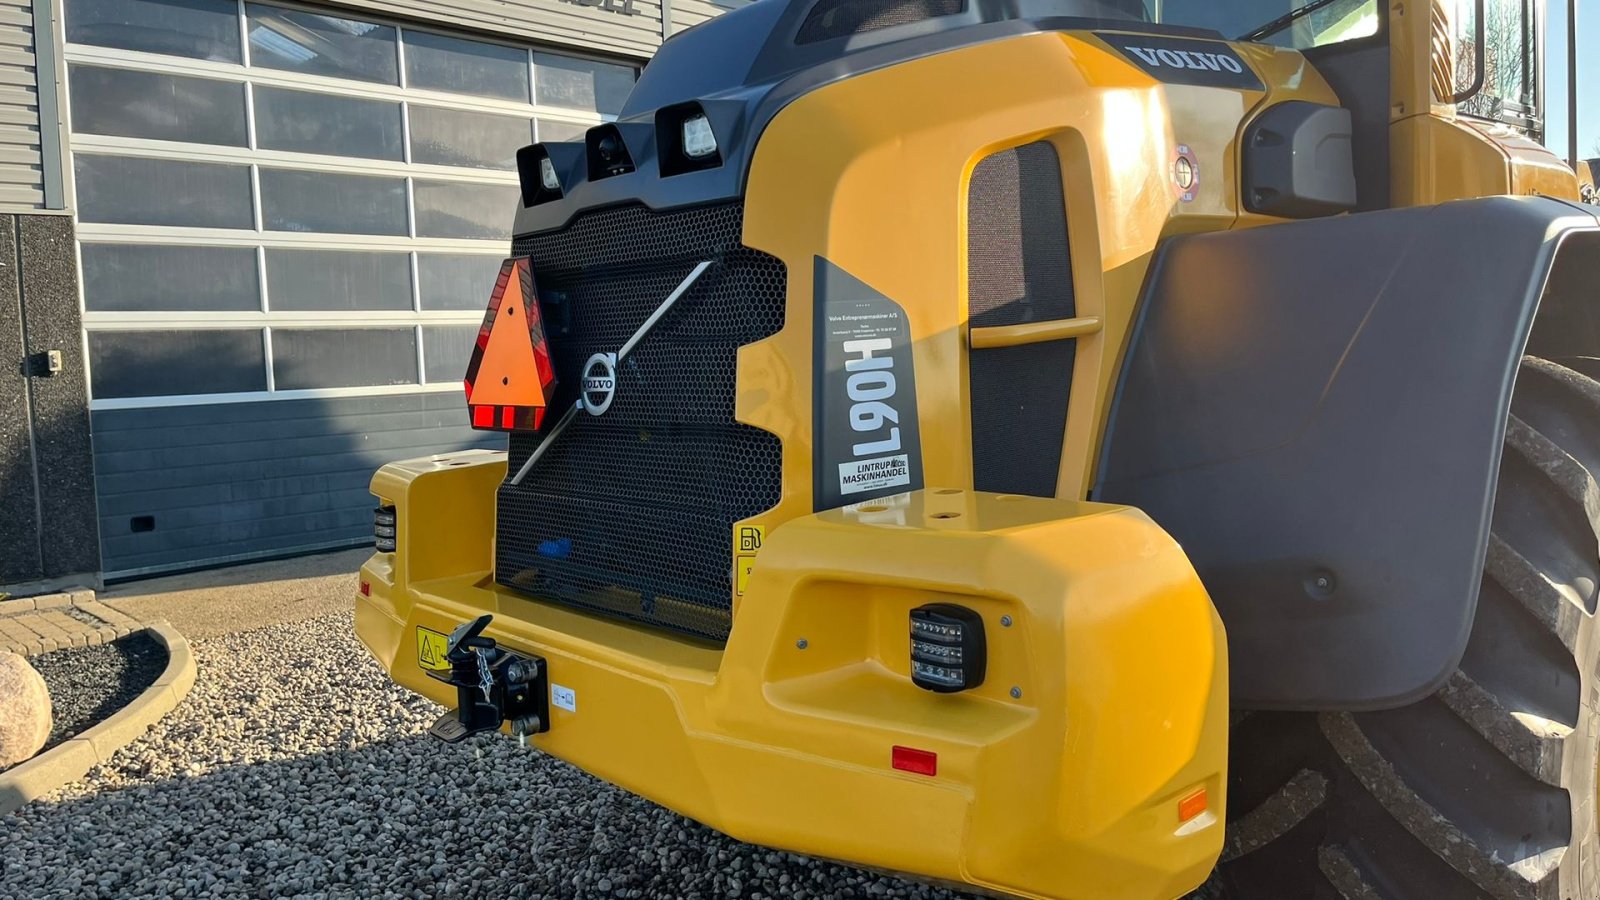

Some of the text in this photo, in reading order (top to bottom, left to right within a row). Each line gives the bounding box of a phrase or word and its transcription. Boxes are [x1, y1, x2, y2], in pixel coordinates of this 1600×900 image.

[1124, 46, 1243, 74] VOLVO
[582, 379, 614, 389] VOLVO
[843, 337, 901, 456] L90H
[842, 467, 907, 485] MASKINHANDEL
[857, 461, 891, 473] LINTRUP
